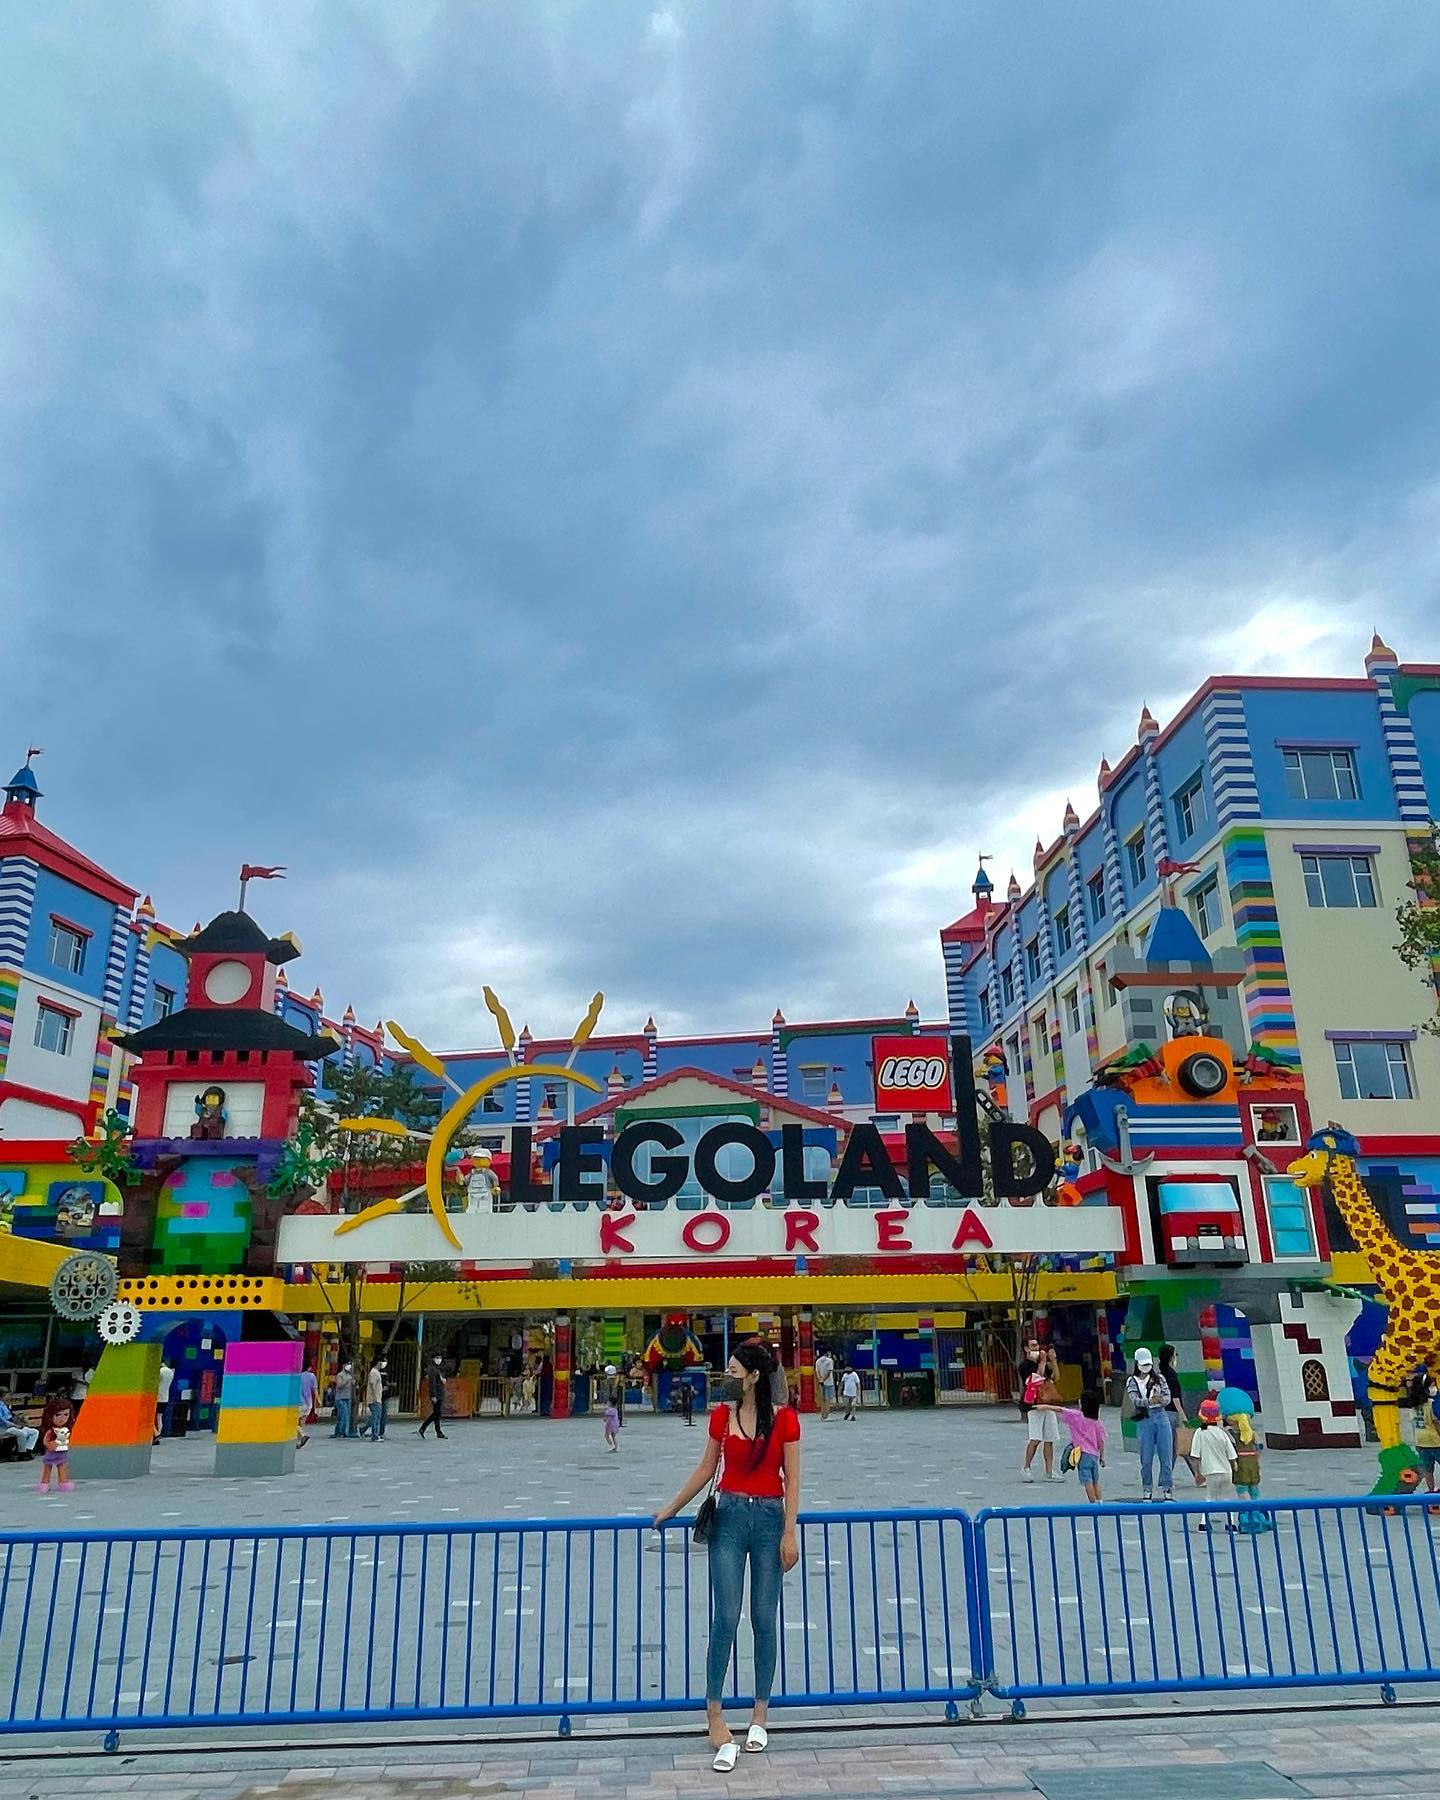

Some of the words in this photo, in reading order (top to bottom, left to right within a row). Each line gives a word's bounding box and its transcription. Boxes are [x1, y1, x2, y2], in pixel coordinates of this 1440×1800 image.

[880, 1058, 944, 1088] LEGO
[509, 1035, 1056, 1202] LEGOLAND
[599, 1209, 993, 1253] KOREA
